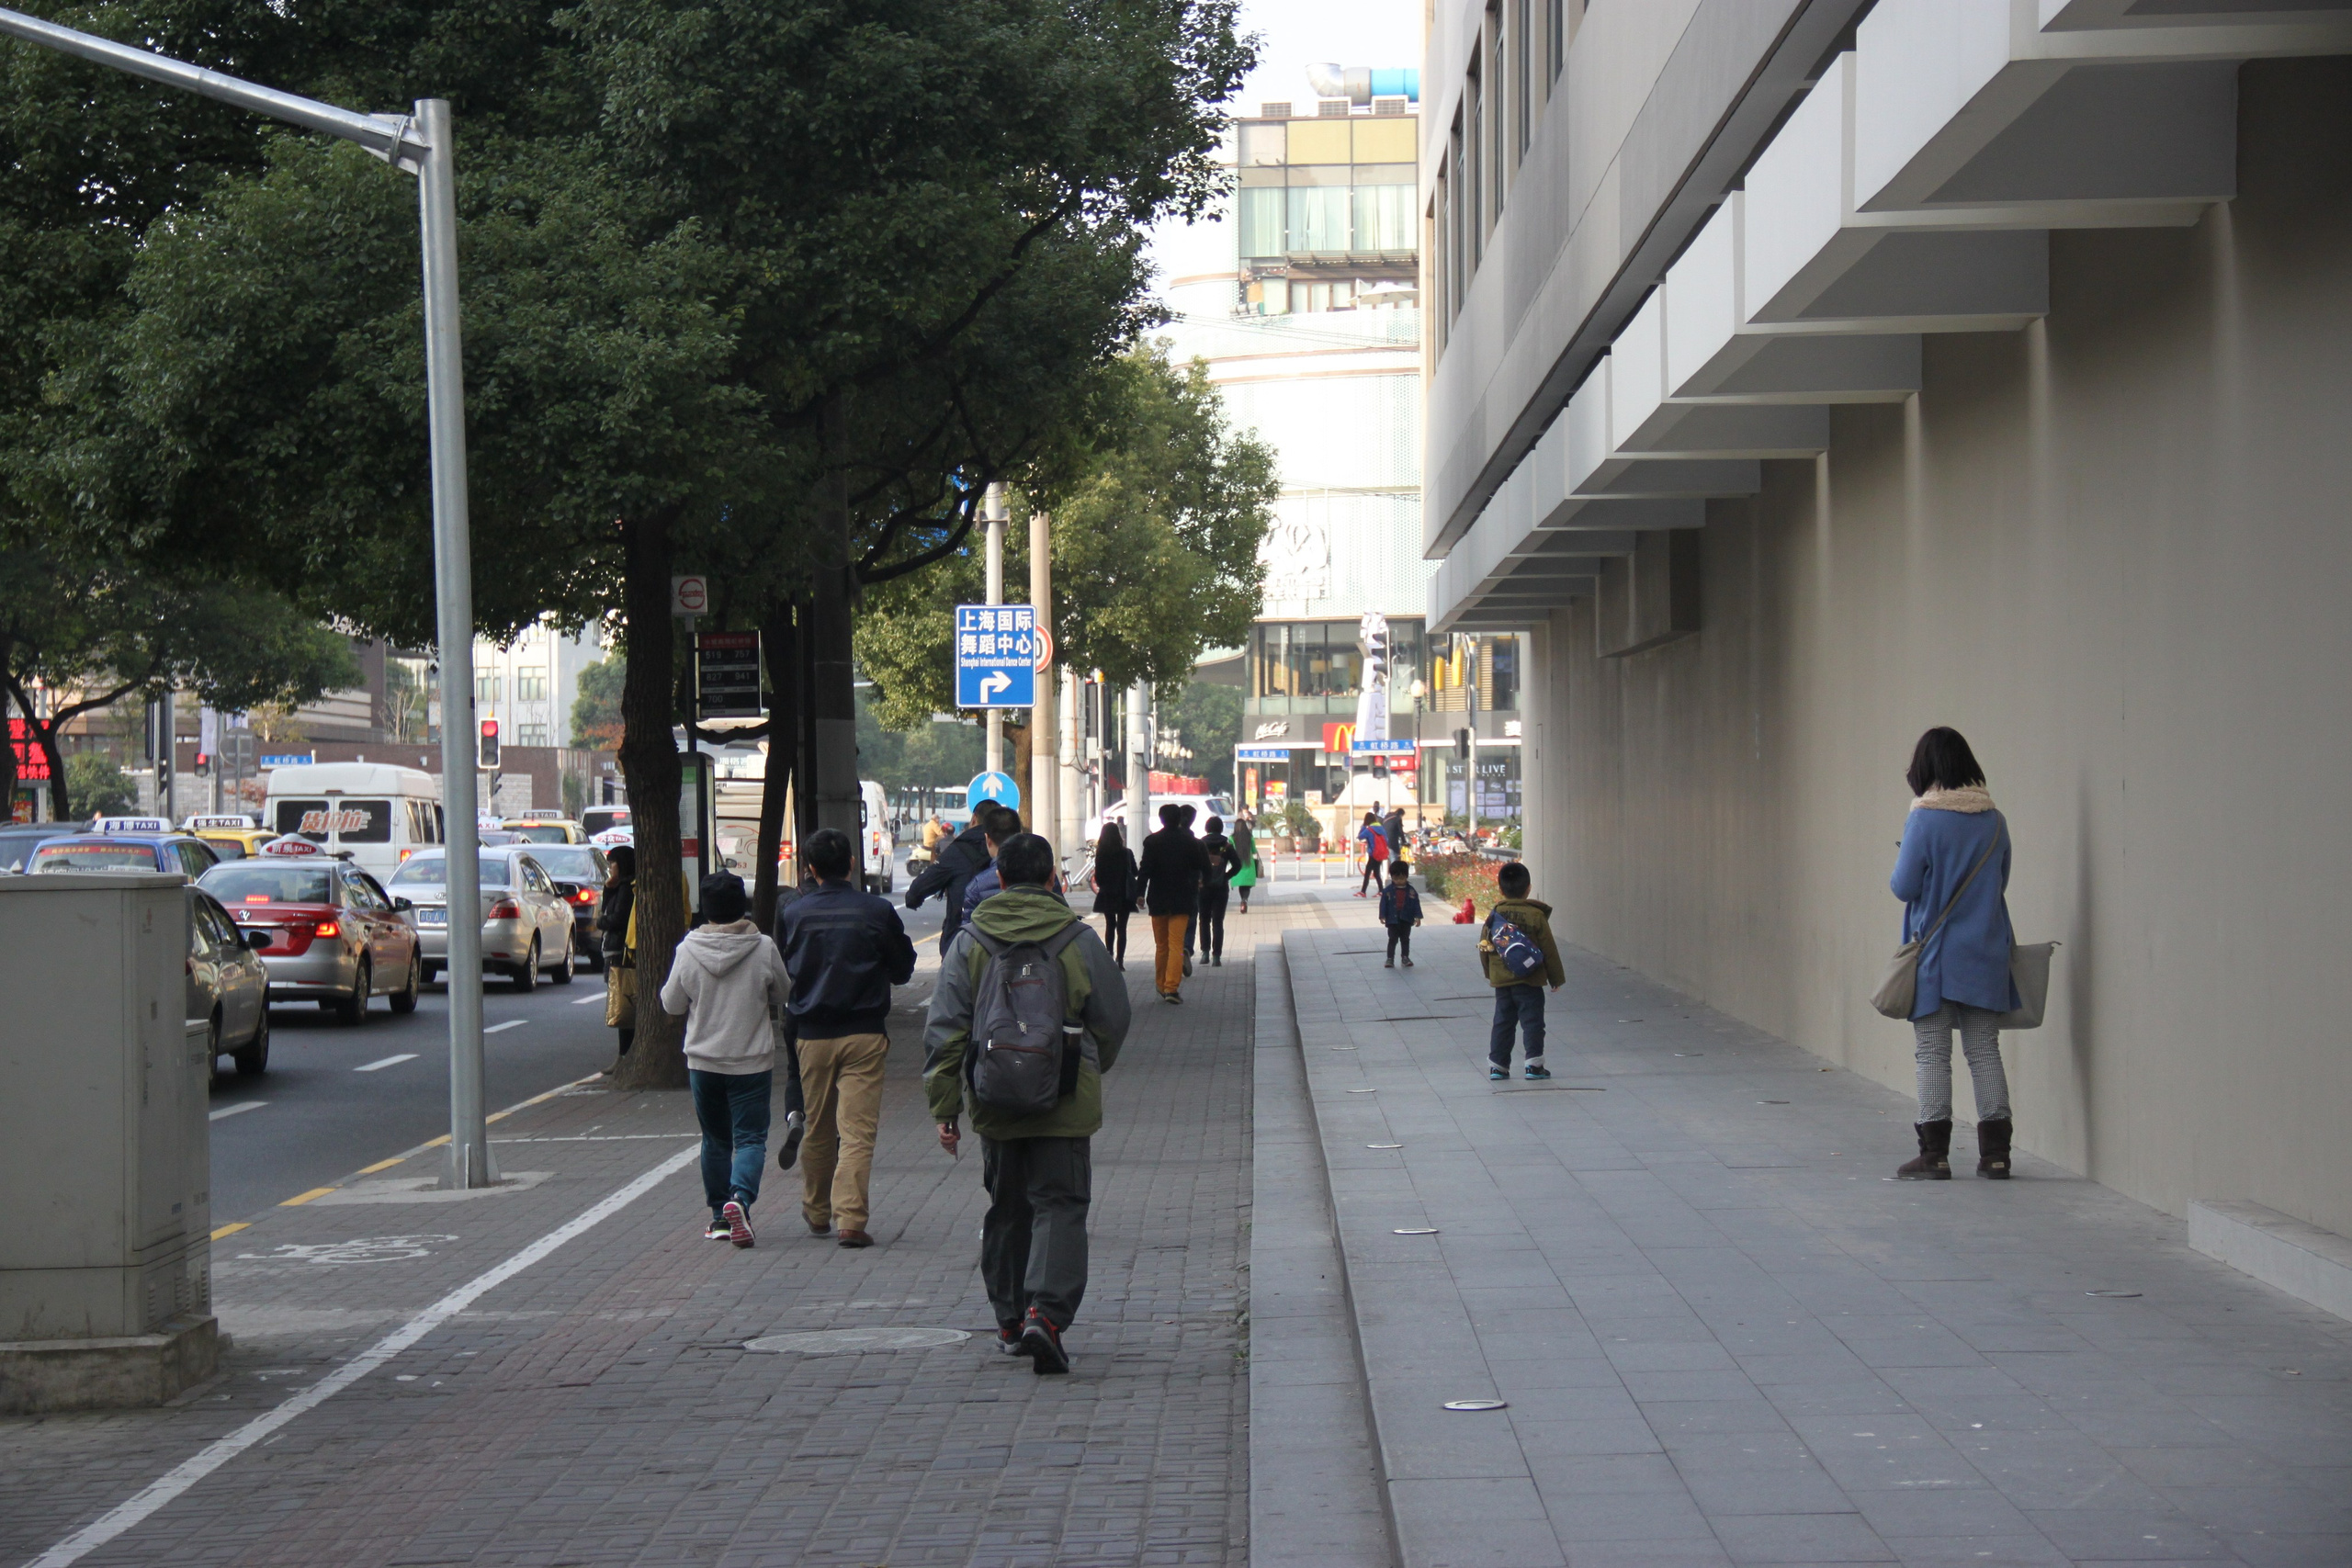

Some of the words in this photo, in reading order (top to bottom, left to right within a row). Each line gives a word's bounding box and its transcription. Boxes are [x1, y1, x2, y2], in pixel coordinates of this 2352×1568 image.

[960, 610, 1032, 632] 上海国际
[960, 633, 1032, 655] 舞蹈中心
[960, 657, 979, 670] Shanghai
[979, 657, 1005, 667] International
[1006, 656, 1018, 667] Dance
[1018, 657, 1032, 667] Center
[707, 695, 724, 704] 700
[1370, 741, 1399, 750] 虹桥路
[1482, 764, 1506, 774] LIVE
